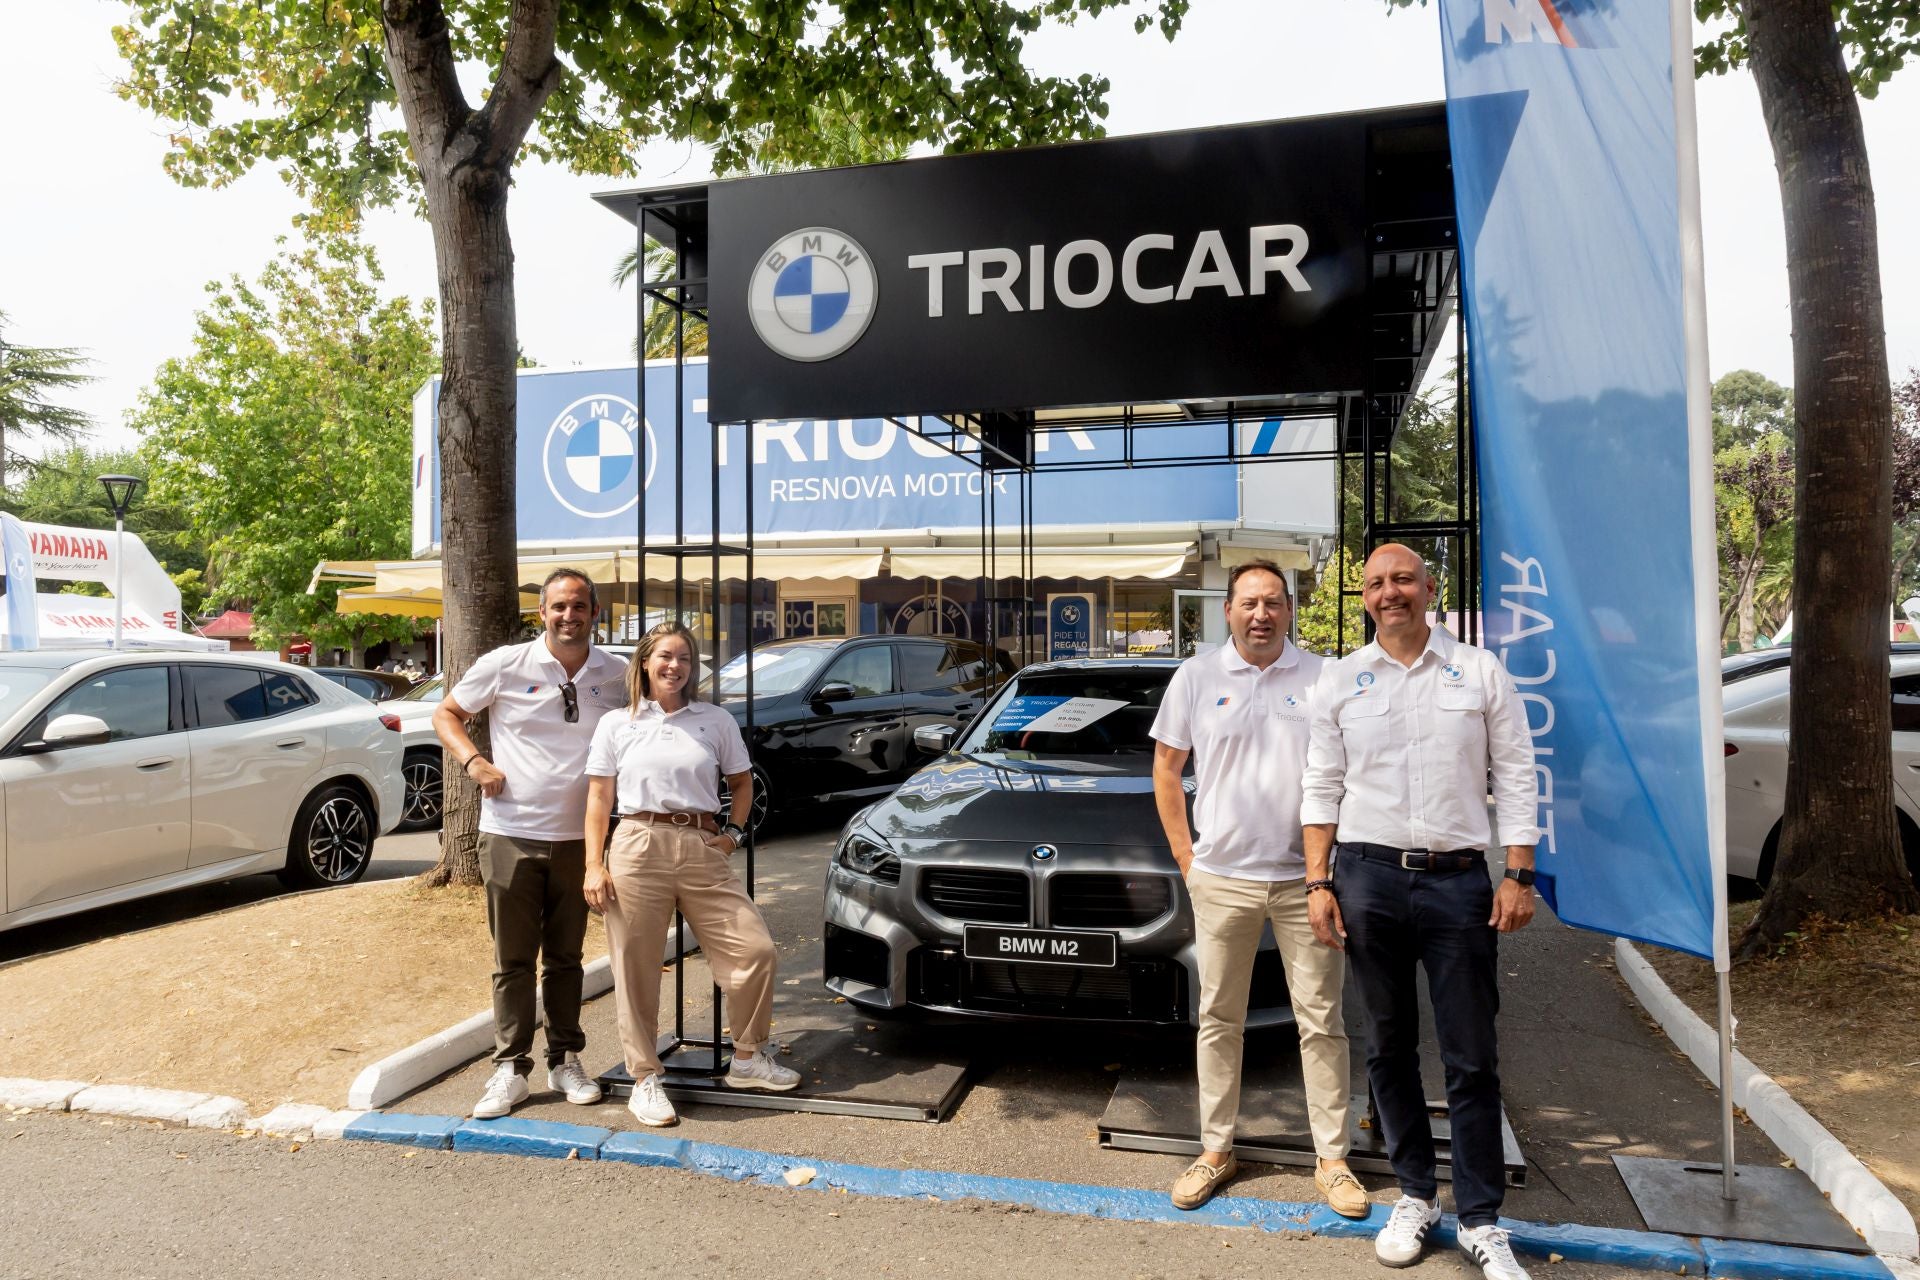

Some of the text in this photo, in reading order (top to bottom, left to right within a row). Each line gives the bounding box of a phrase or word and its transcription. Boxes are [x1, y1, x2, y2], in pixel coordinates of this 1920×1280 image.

[766, 235, 859, 273] BMW
[908, 223, 1312, 318] TRIOCAR
[559, 400, 638, 437] BMW
[770, 471, 1008, 503] RESNOVA MOTOR
[1054, 631, 1086, 639] PIDE TU
[1054, 641, 1088, 649] REGALO
[999, 936, 1079, 956] BMW M2
